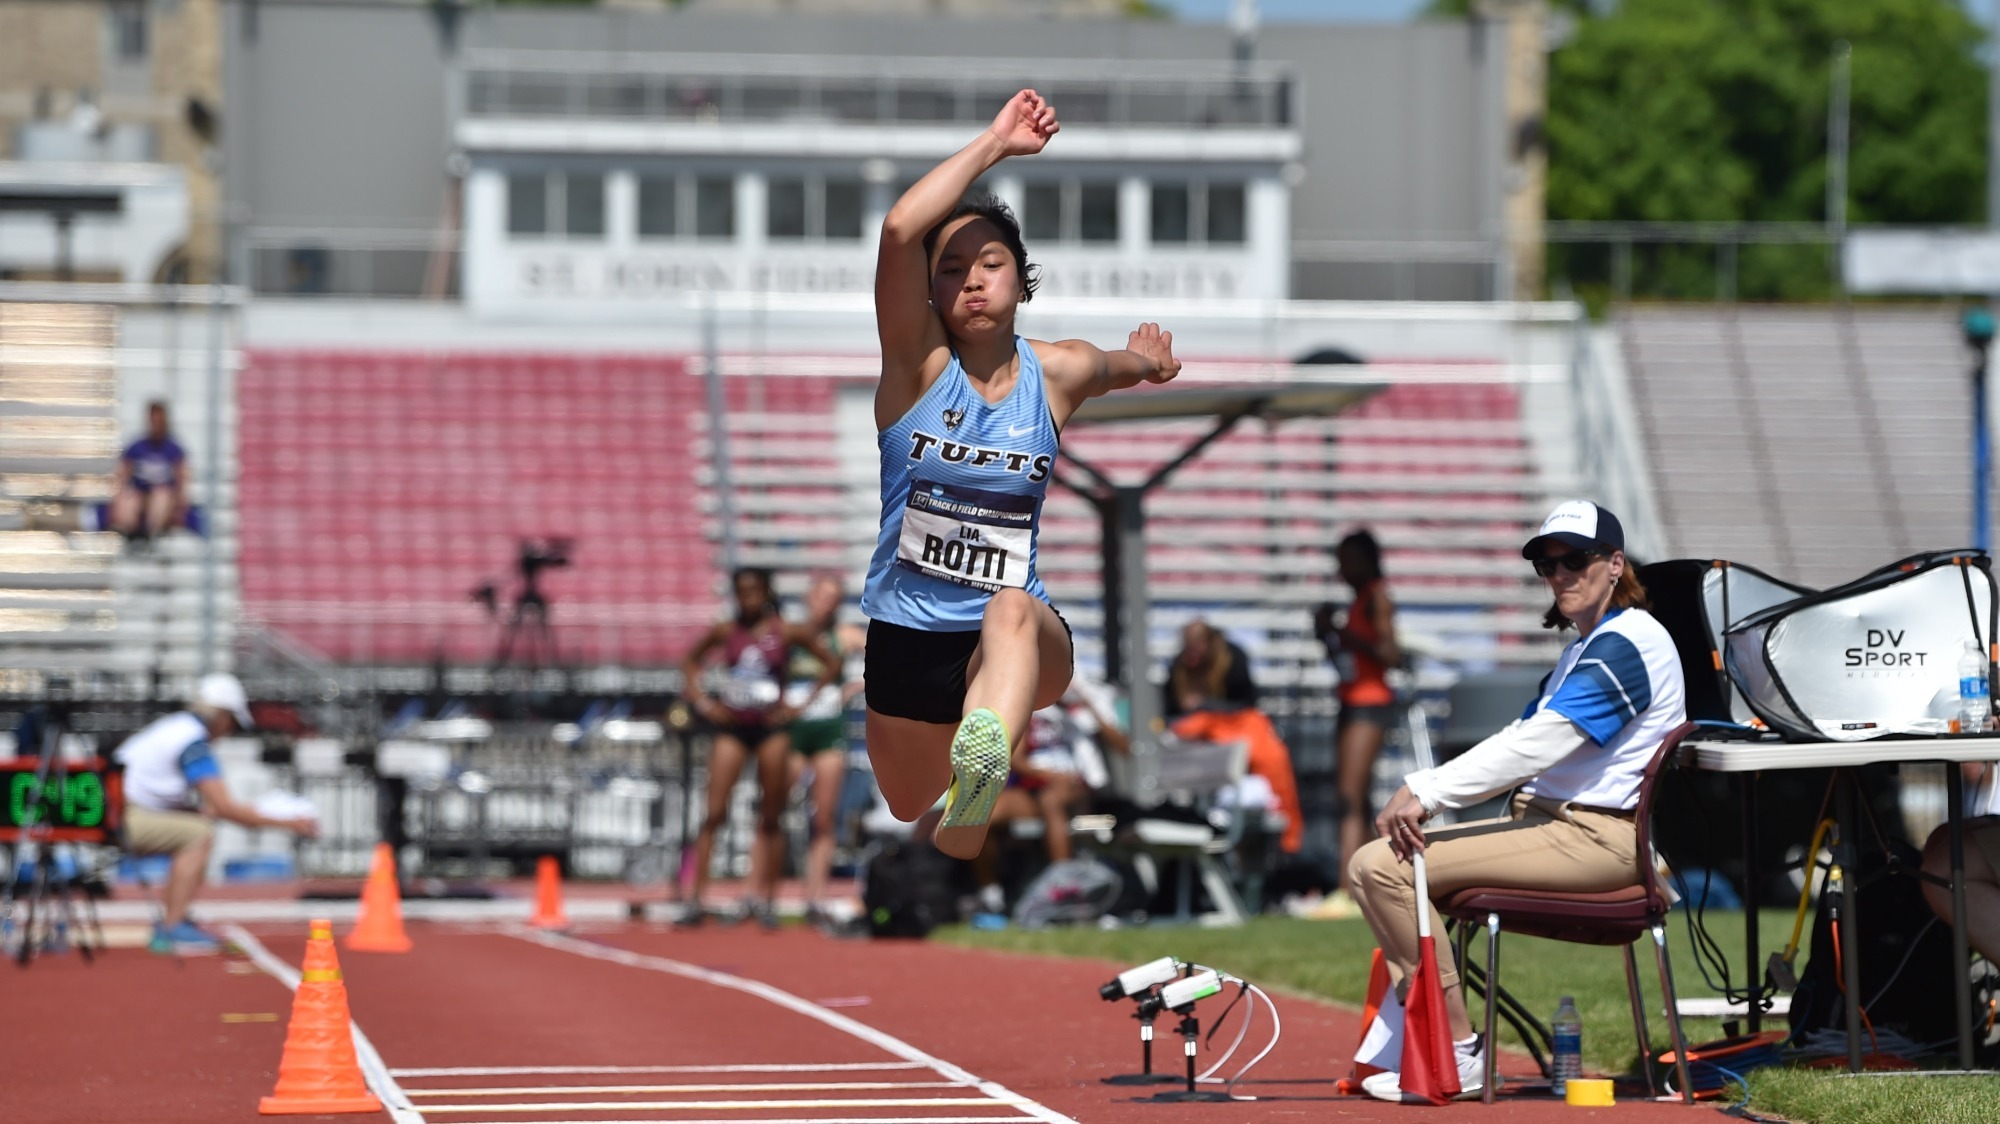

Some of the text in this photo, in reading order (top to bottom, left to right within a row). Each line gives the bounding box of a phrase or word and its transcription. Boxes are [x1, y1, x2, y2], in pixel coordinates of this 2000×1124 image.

[909, 430, 1052, 484] TUFTS
[928, 498, 952, 511] TRACK
[957, 504, 978, 516] FIELD
[977, 507, 1032, 521] CHAMPIONSHIPS
[959, 525, 980, 542] LIA
[922, 533, 1008, 580] ROTTI
[1867, 629, 1905, 648] DV
